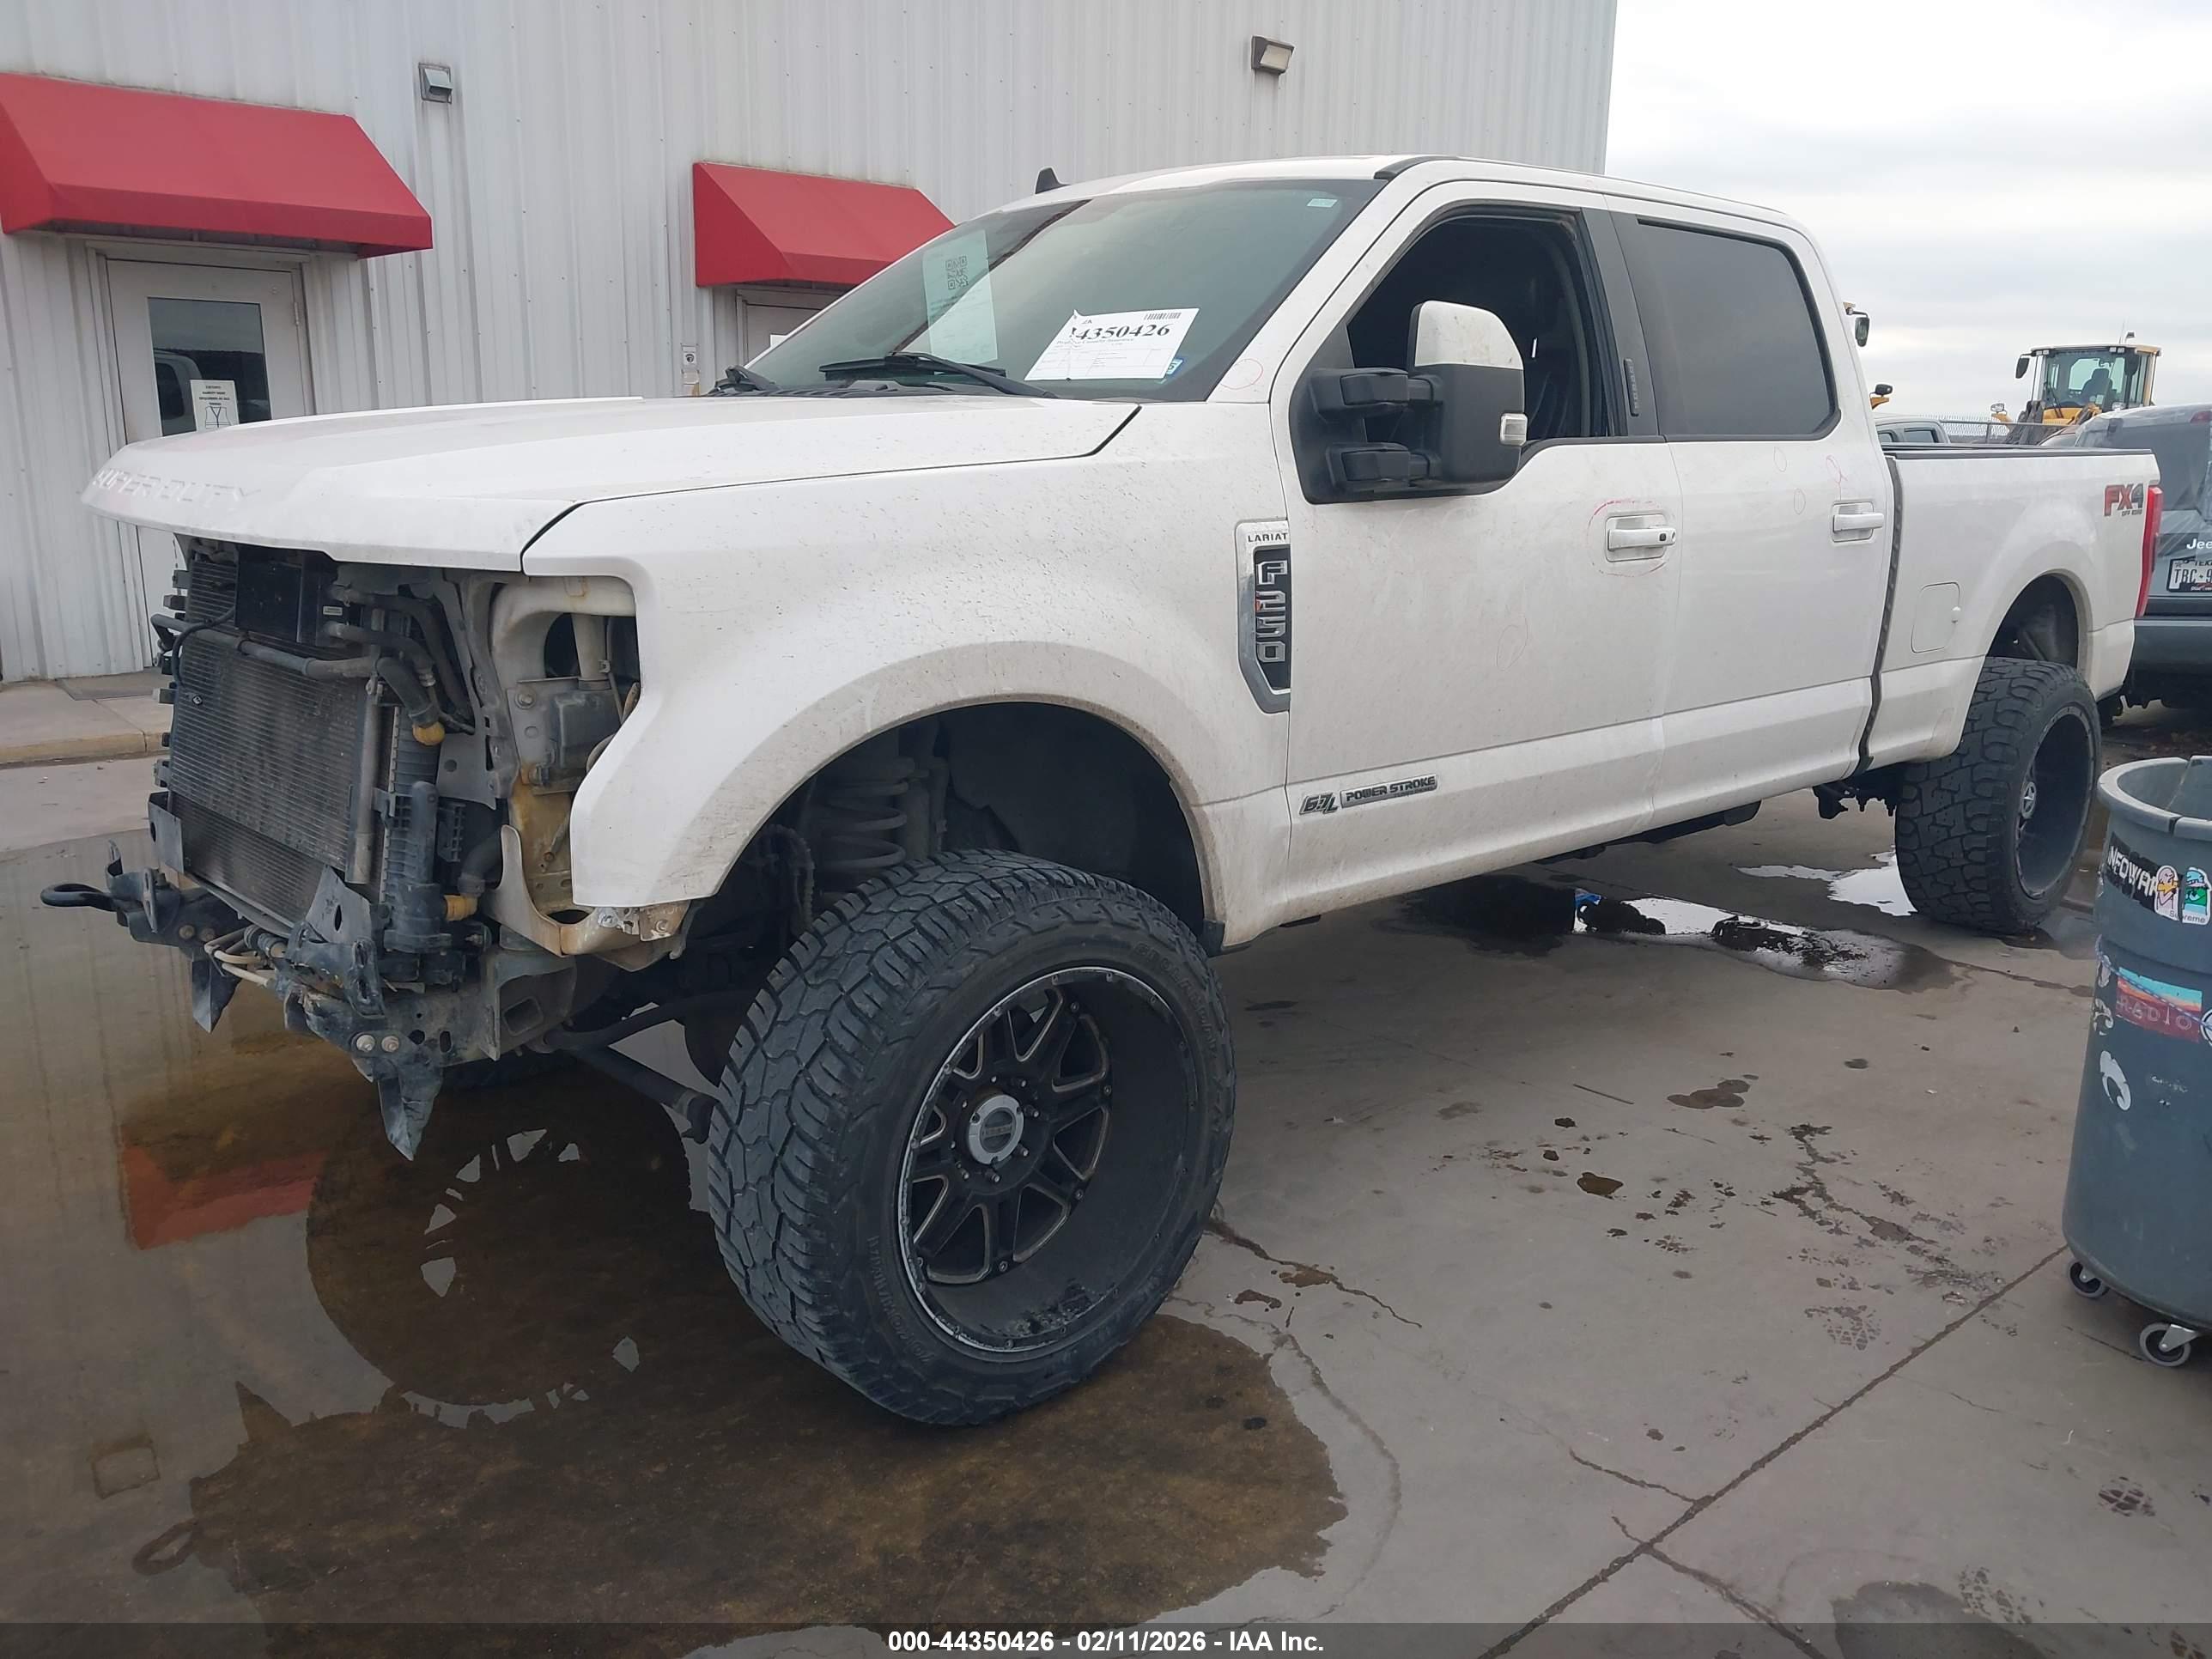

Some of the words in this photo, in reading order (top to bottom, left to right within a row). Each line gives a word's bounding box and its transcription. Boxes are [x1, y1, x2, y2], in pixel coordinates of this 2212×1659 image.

[2104, 483, 2144, 517] FX4
[1247, 532, 1289, 544] LARIAT
[1255, 560, 1289, 662] F250
[1301, 793, 1339, 815] 6.7L
[1346, 785, 1388, 803] POWER
[1389, 775, 1436, 793] STROKE
[2169, 909, 2206, 923] Sureme
